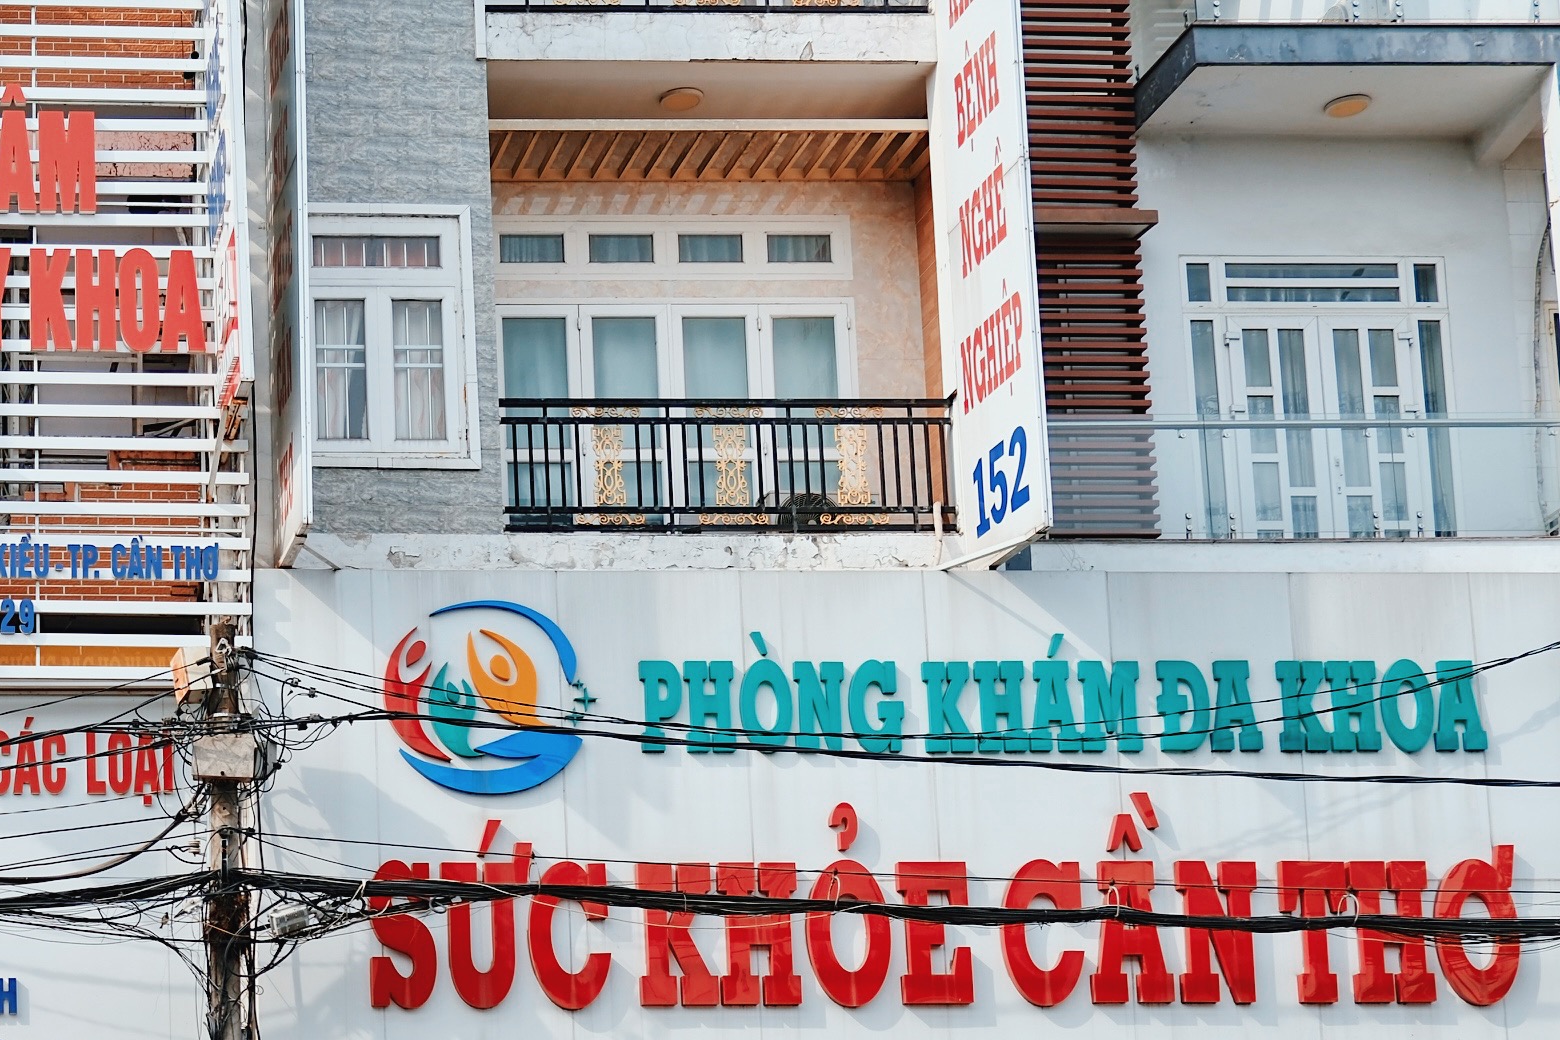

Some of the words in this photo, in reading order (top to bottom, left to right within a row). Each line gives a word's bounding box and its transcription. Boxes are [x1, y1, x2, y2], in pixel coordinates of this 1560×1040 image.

[953, 30, 1001, 152] BỆNH
[958, 136, 1008, 279] NGHỀ
[30, 247, 208, 353] KHOA
[960, 278, 1023, 416] NGHIỆP
[972, 425, 1031, 539] 152
[112, 535, 163, 580] CẦN
[170, 542, 220, 581] THƠ
[638, 631, 905, 754] PHÒNG
[920, 633, 1145, 754] KHÁM
[1156, 660, 1264, 752] ĐA
[1274, 658, 1489, 753] KHOA
[85, 730, 175, 807] LOẠI
[368, 819, 613, 1011] SỨC
[634, 802, 975, 1009] KHỎE
[1001, 792, 1257, 1008] CẦN
[1276, 844, 1522, 1007] THƠ
